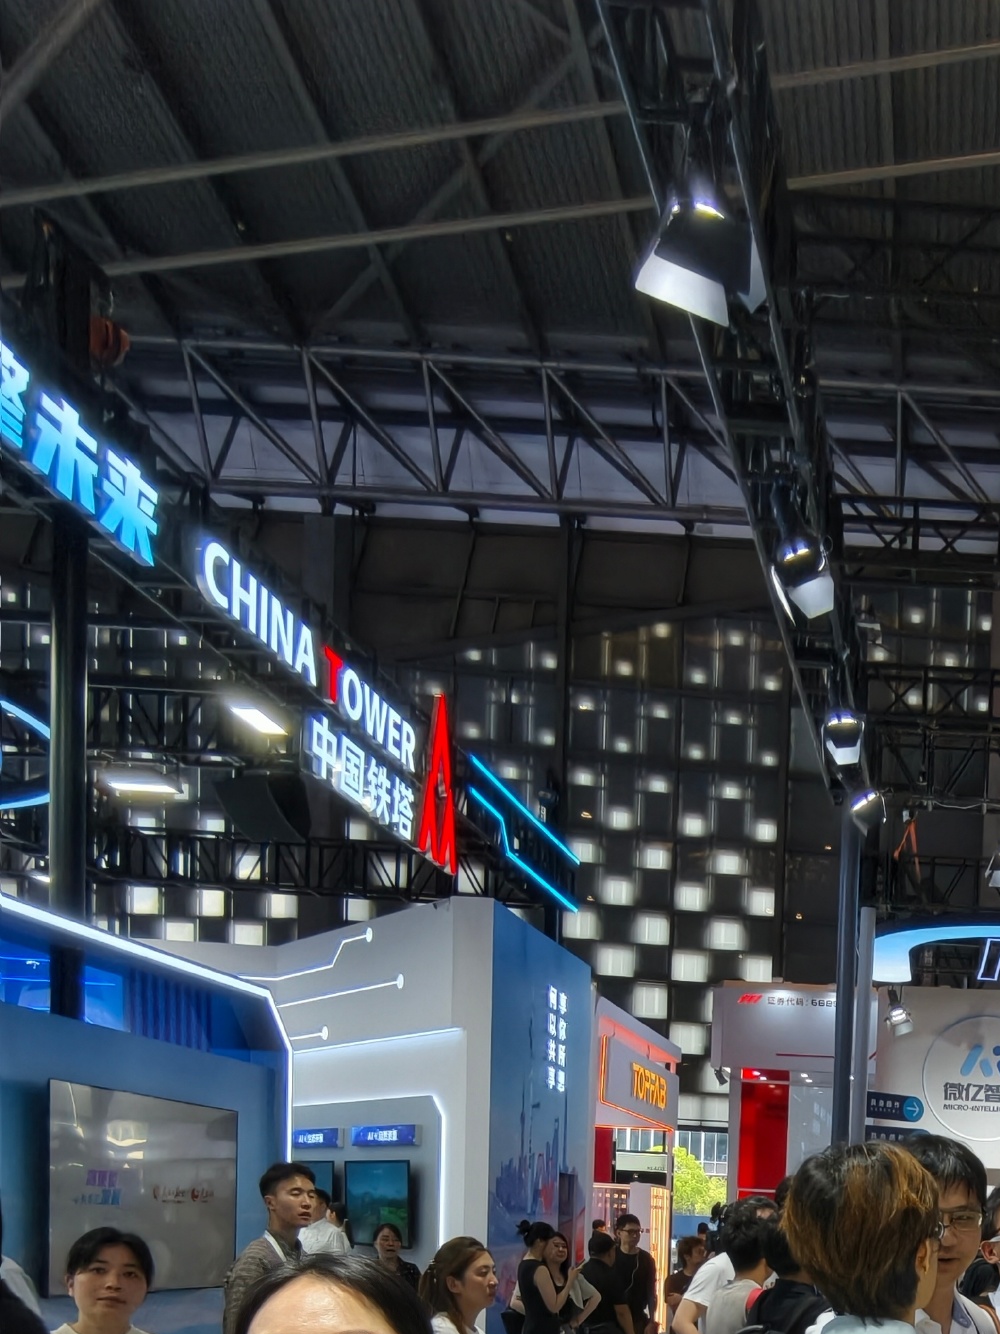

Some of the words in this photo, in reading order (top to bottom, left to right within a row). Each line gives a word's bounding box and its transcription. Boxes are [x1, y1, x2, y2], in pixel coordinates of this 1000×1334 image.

[203, 541, 317, 687] CHINA
[324, 645, 415, 773] TOWER
[311, 713, 414, 841] 中国铁塔
[631, 1061, 668, 1111] TOPFAB
